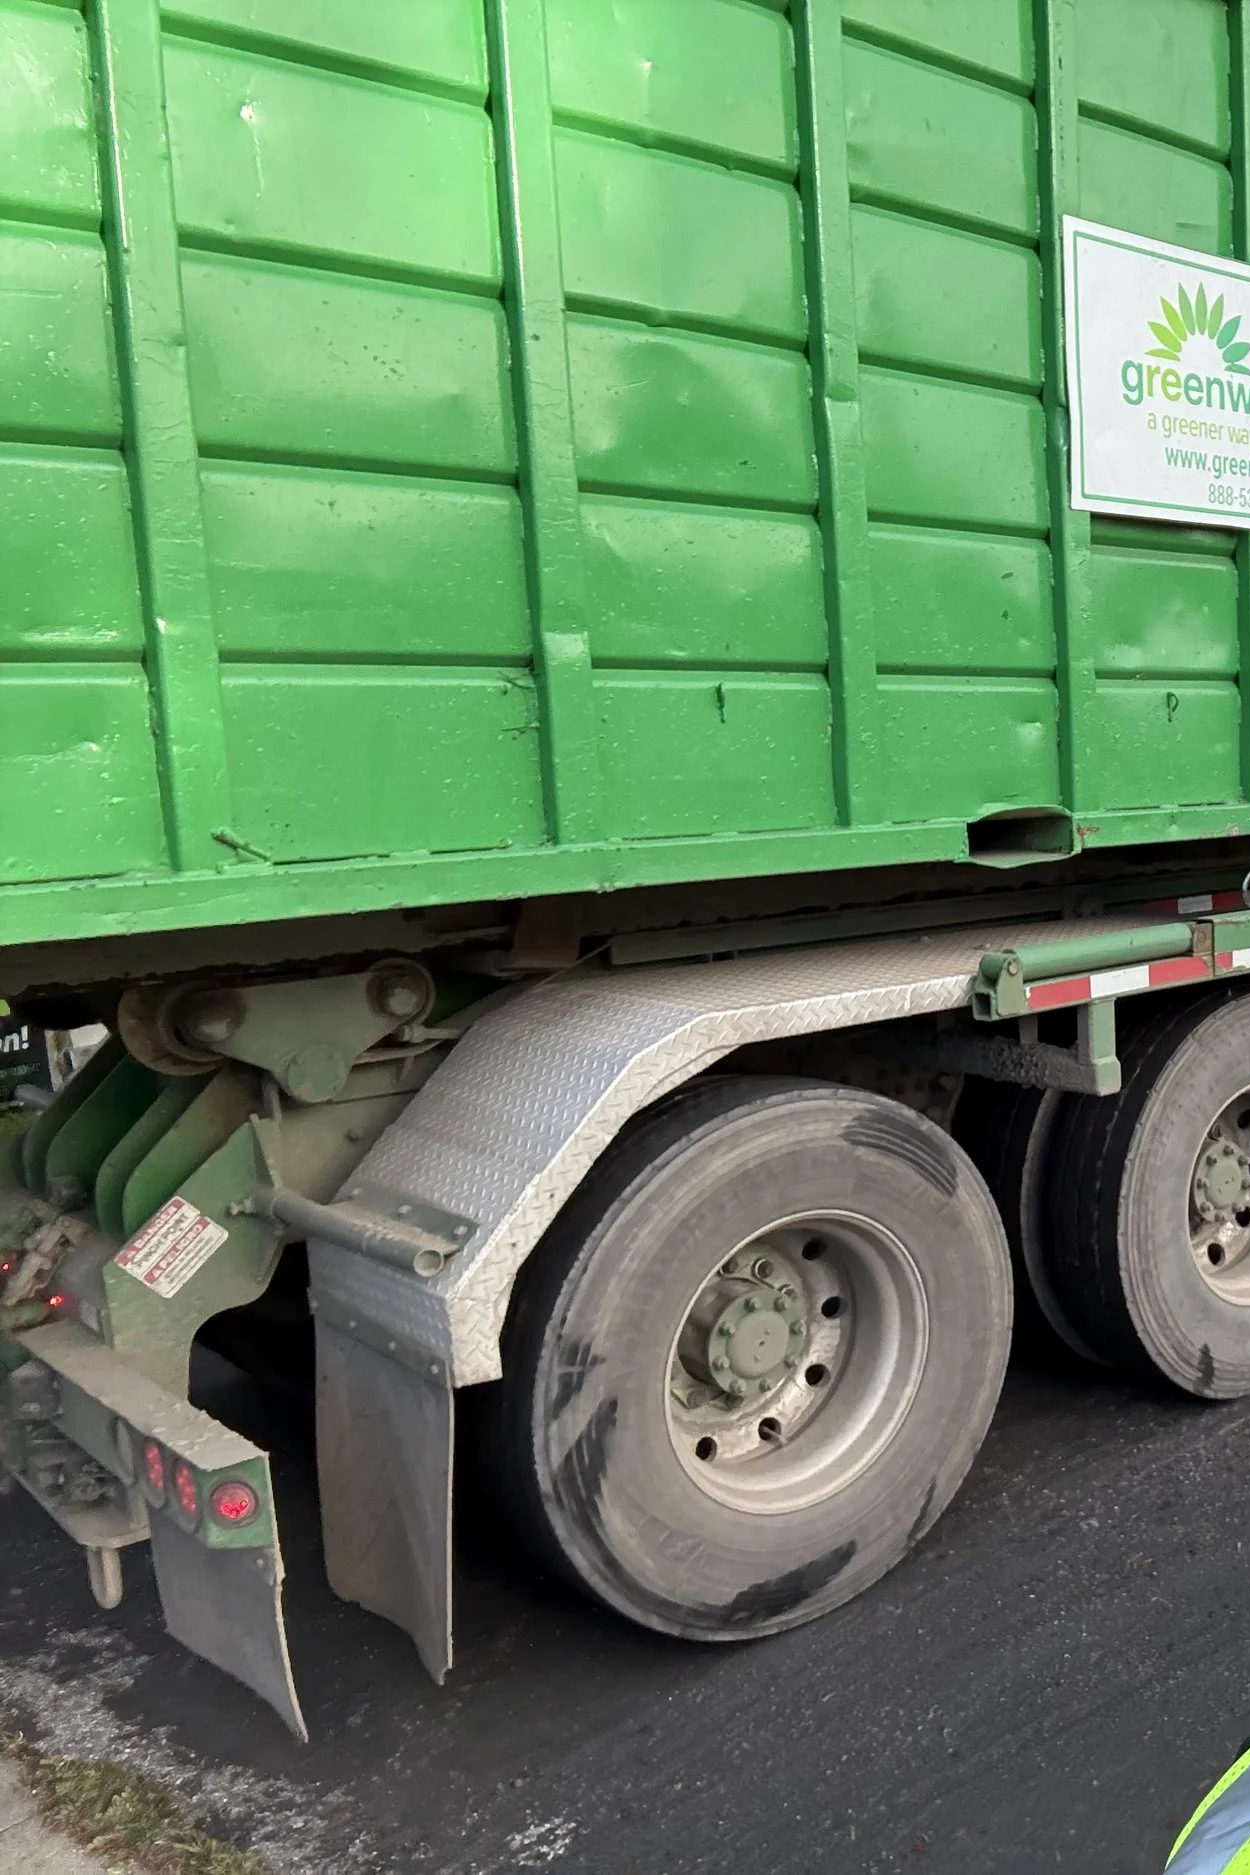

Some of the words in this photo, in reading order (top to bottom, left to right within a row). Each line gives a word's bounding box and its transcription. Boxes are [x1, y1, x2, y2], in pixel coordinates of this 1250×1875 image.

[1148, 413, 1157, 430] a
[1162, 414, 1223, 441] greener
[0, 1025, 29, 1053] n!
